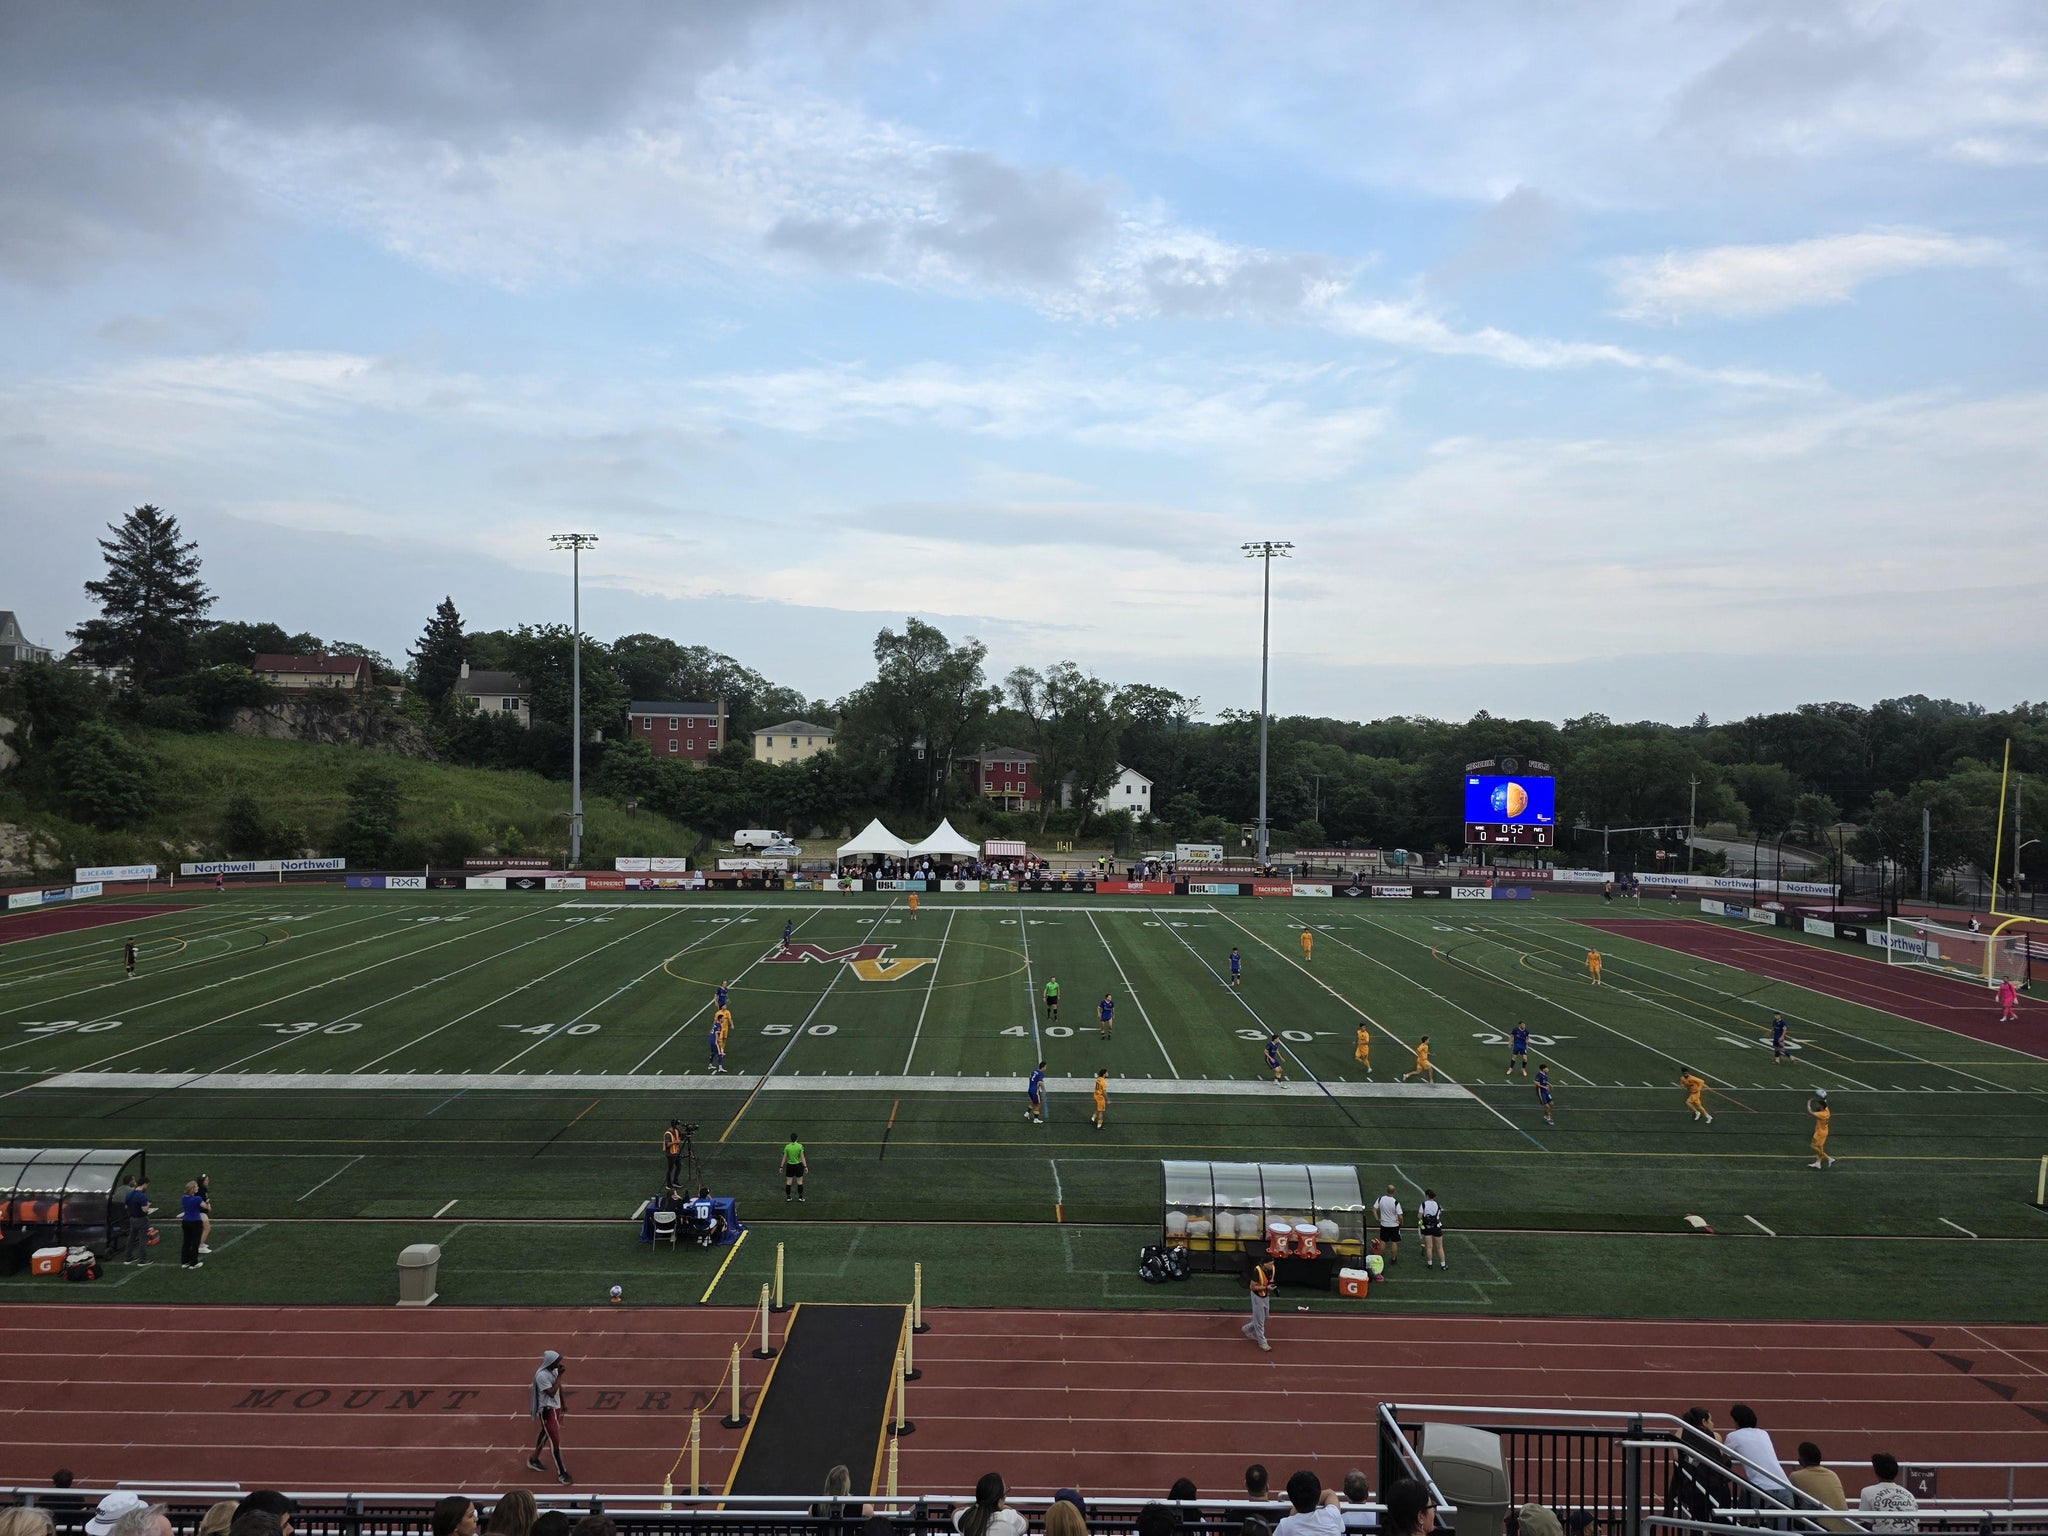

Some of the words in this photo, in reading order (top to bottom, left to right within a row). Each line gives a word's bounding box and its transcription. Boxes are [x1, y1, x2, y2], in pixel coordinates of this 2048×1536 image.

[1501, 824, 1524, 834] 0:52
[1480, 831, 1487, 841] 0
[1538, 833, 1545, 843] 0
[194, 862, 256, 873] Northwell
[281, 859, 339, 870] Northwell
[1522, 870, 1549, 878] FIELD
[391, 878, 420, 887] RXR
[878, 881, 896, 890] USL
[1644, 875, 1689, 885] Northwell
[1190, 884, 1208, 893] USL
[1457, 888, 1485, 898] RXR
[24, 1020, 123, 1033] 20
[275, 1022, 363, 1034] 30
[519, 1023, 602, 1035] 40
[760, 1024, 839, 1036] 50
[1000, 1025, 1074, 1038] 40
[1234, 1029, 1313, 1042] 30
[697, 1206, 709, 1219] 10
[1277, 1237, 1288, 1247] G
[1304, 1238, 1313, 1247] G
[39, 1260, 52, 1272] G
[1347, 1282, 1358, 1294] G
[233, 1388, 481, 1410] MOUNT
[1918, 1479, 1928, 1493] 4
[1881, 1497, 1912, 1509] Ranch
